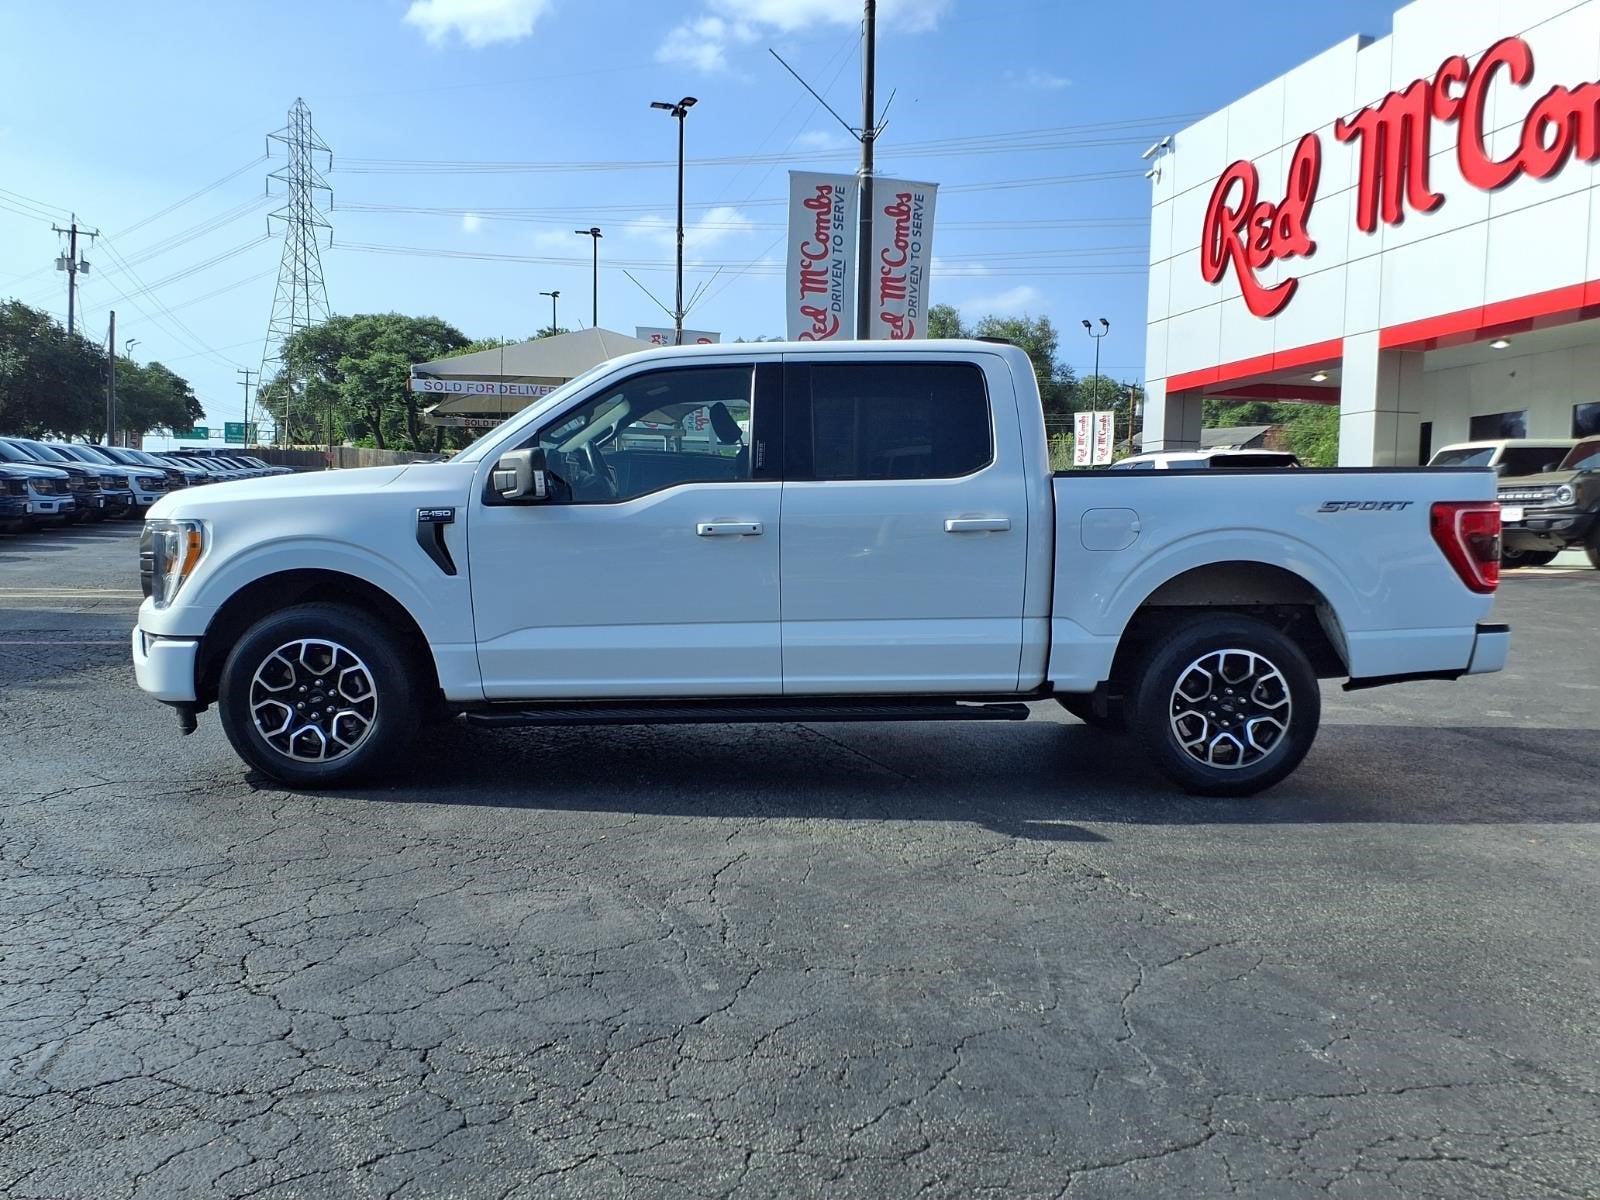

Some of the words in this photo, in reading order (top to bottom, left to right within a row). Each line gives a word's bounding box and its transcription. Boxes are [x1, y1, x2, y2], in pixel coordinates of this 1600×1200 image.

[833, 185, 845, 231] SERVE
[912, 193, 924, 238] SERVE
[1201, 133, 1321, 318] Red
[800, 185, 833, 301] McCombs
[833, 235, 844, 255] TO
[880, 192, 912, 307] McCombs
[910, 243, 922, 261] TO
[831, 259, 843, 313] DRIVEN
[908, 266, 920, 318] DRIVEN
[880, 311, 915, 340] ed
[424, 381, 462, 392] SOLD
[467, 383, 495, 394] FOR
[464, 419, 489, 427] SOLD
[1317, 501, 1414, 512] SPORT
